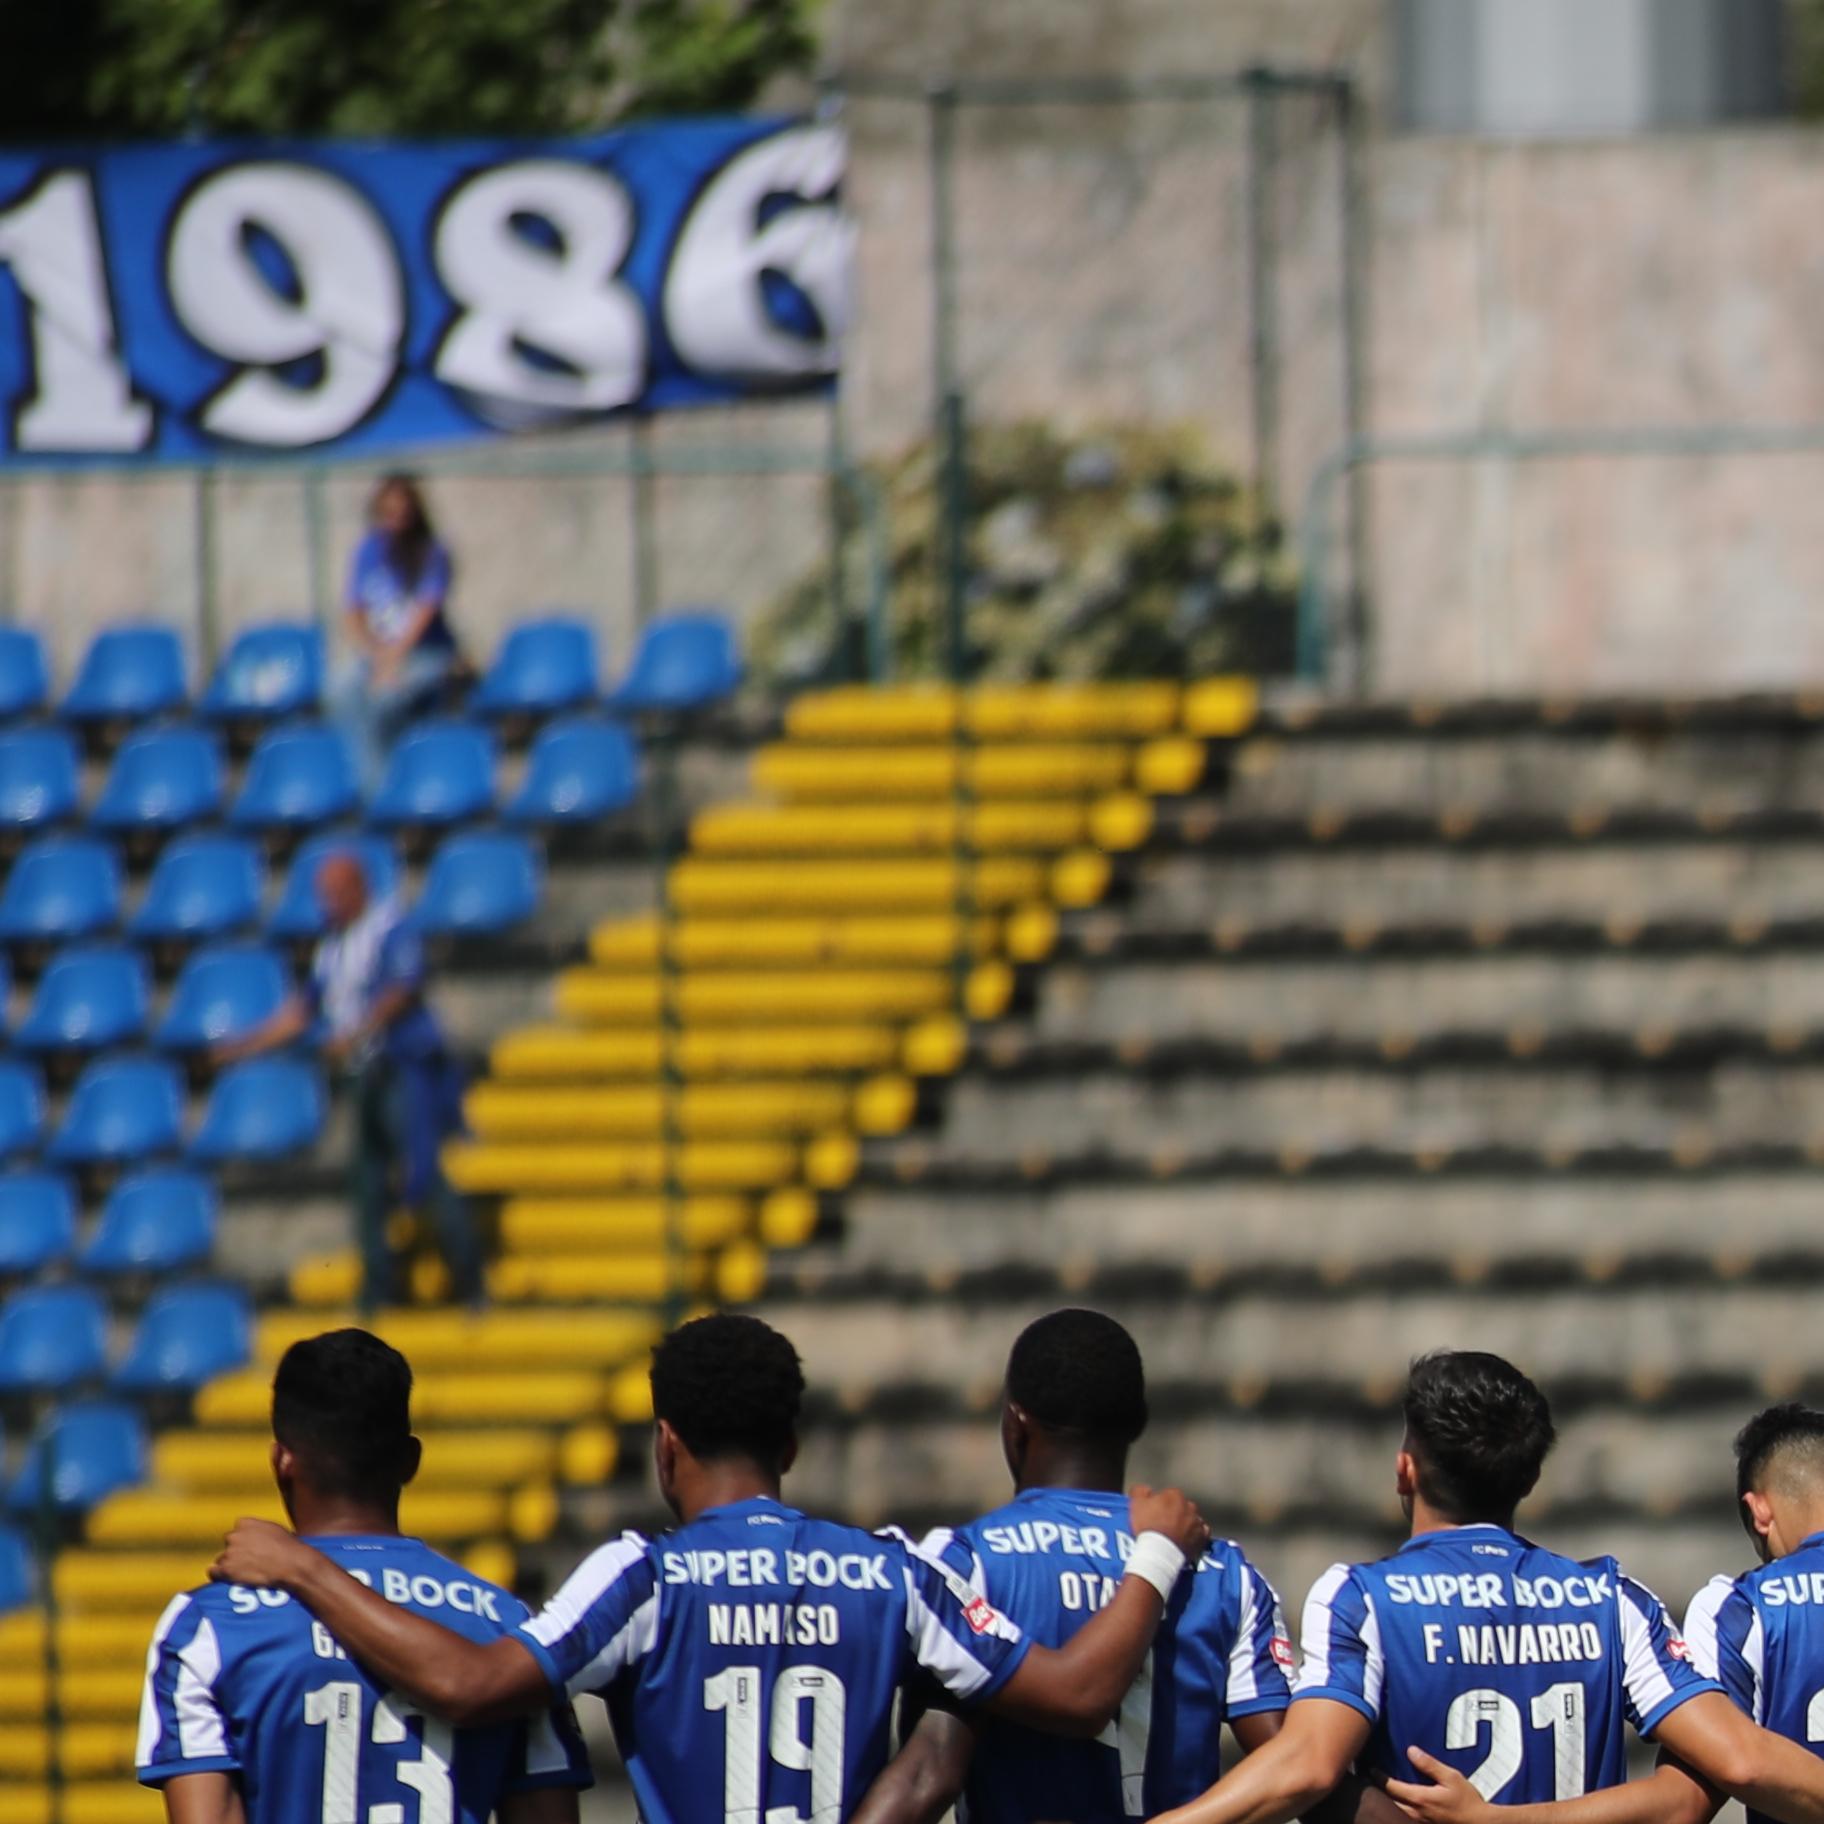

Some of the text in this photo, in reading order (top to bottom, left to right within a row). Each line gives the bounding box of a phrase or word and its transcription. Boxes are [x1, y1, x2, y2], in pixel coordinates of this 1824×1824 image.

[0, 122, 855, 452] 1986
[982, 1520, 1111, 1560] SUPER
[663, 1548, 894, 1591] SUPER BOCK
[1386, 1573, 1612, 1608] SUPER BOCK
[382, 1569, 500, 1622] BOCK
[1423, 1623, 1602, 1664] F. NAVARRO
